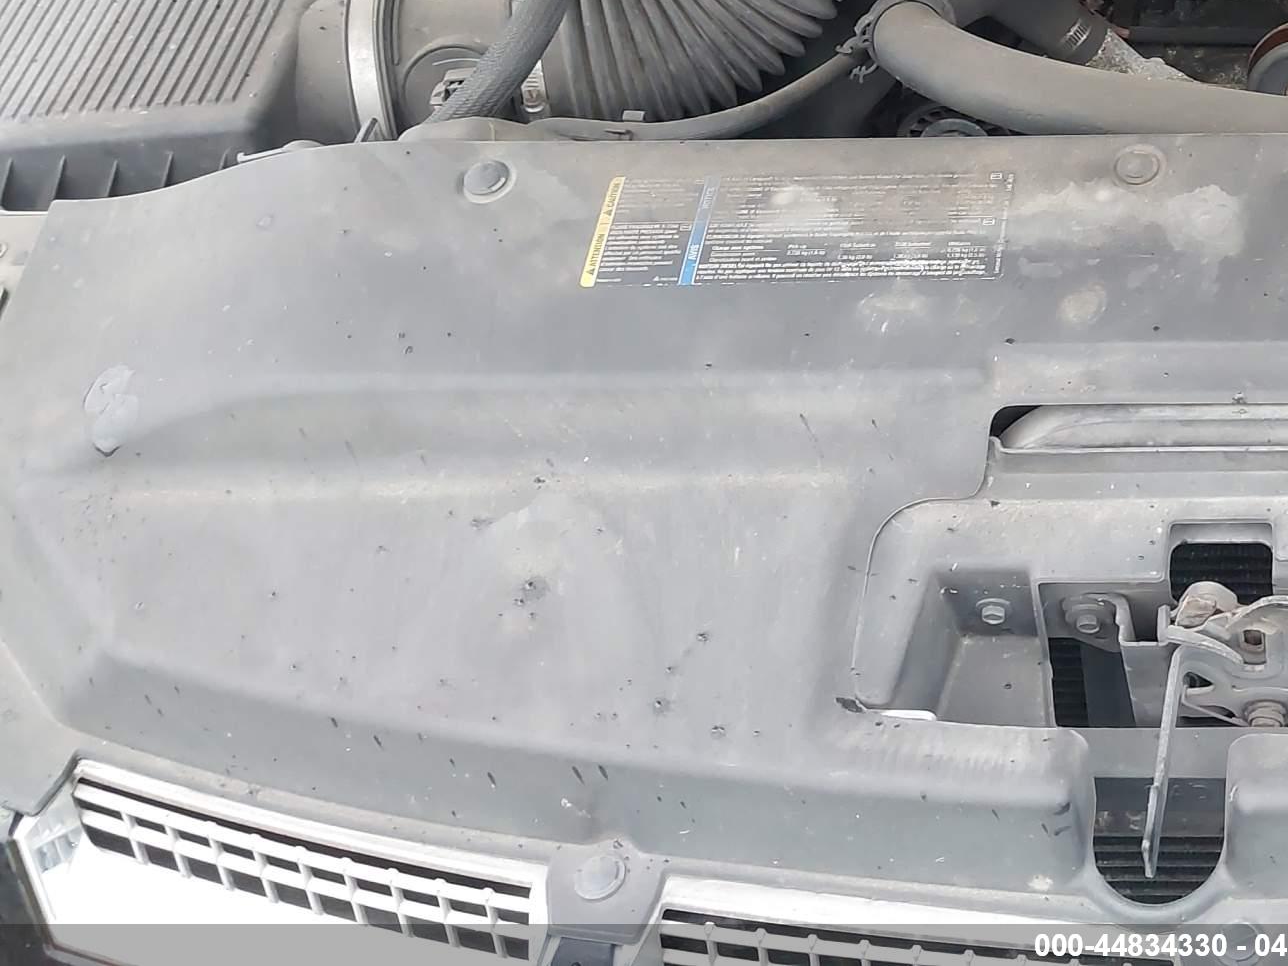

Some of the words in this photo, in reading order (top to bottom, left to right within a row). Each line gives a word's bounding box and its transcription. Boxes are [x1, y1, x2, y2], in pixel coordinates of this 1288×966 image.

[607, 182, 620, 208] CAUTION
[590, 233, 604, 268] ATTENTION
[688, 244, 700, 261] AVIS
